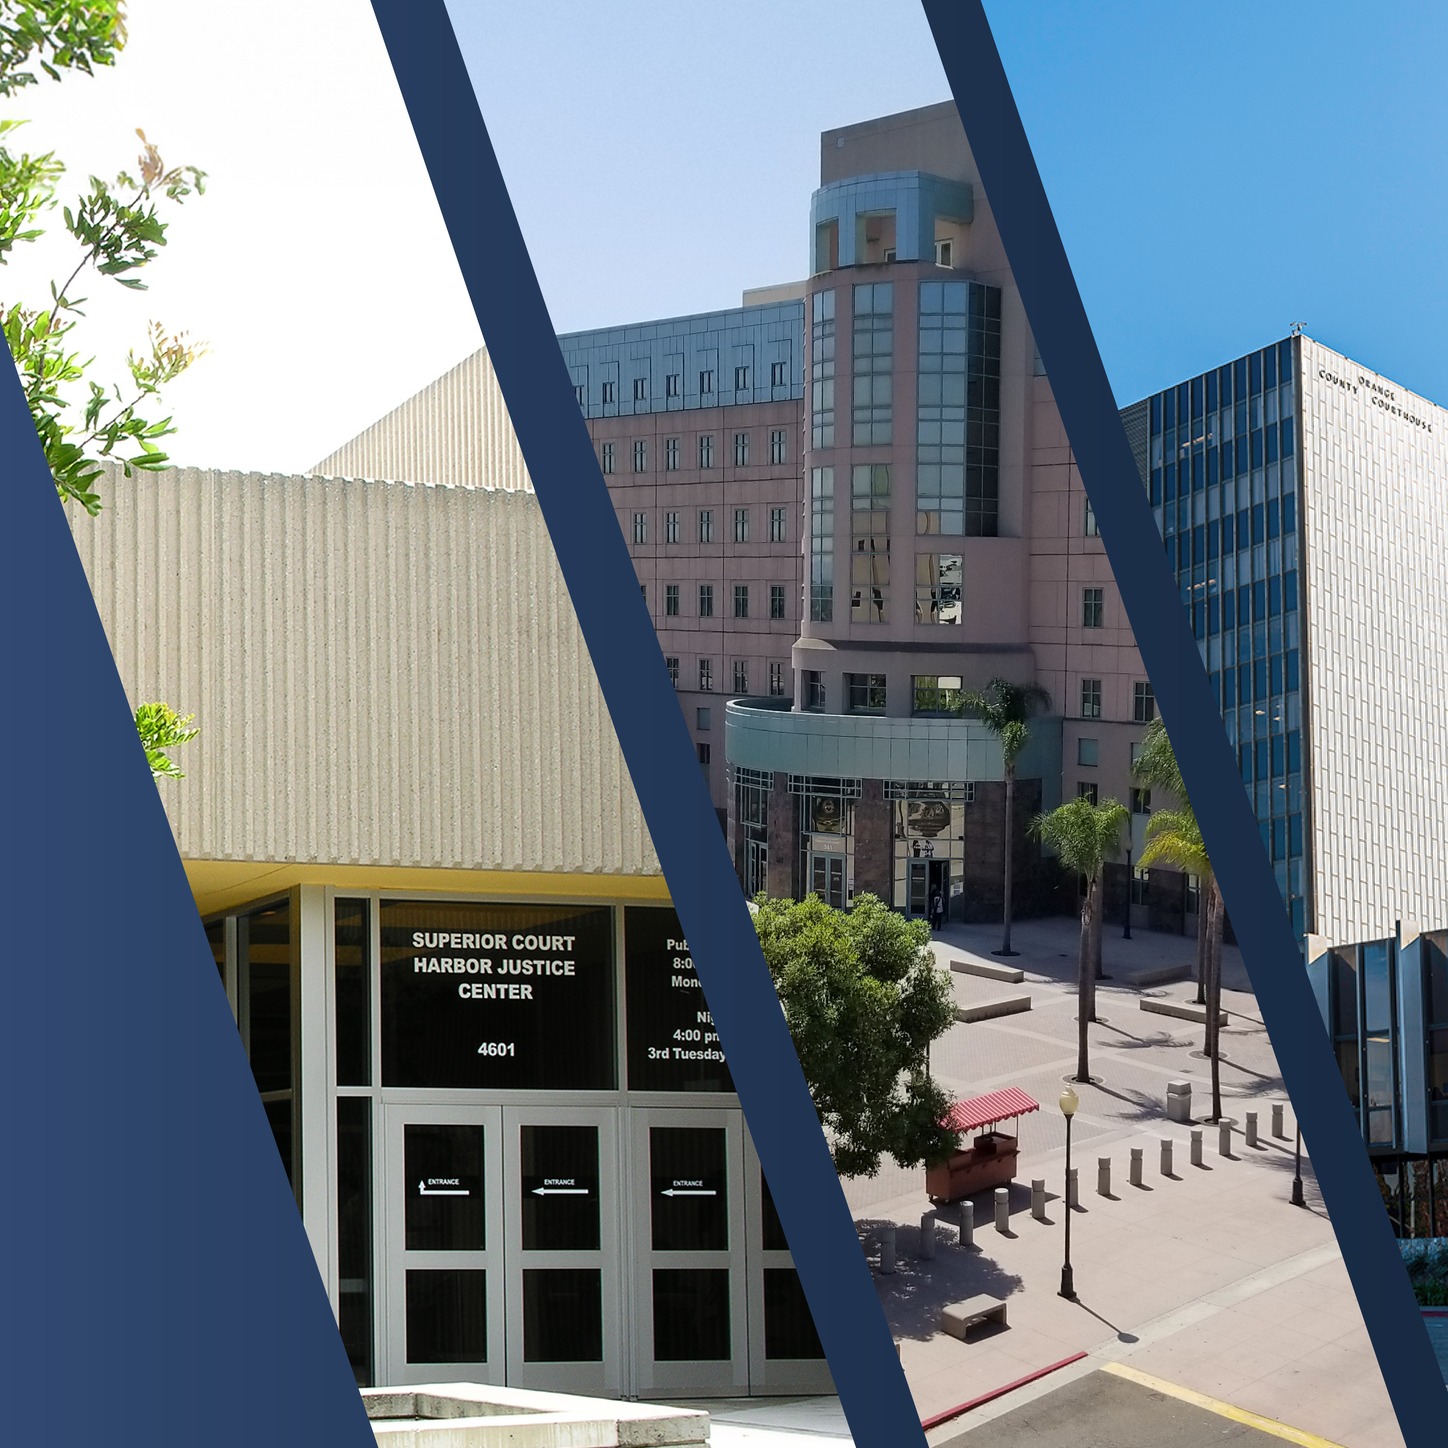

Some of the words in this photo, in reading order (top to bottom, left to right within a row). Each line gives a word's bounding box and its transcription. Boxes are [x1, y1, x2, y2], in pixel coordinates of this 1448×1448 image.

[1358, 376, 1396, 401] ORANGE
[1319, 370, 1359, 394] COUNTY
[1371, 396, 1433, 434] COURTHOUSE
[412, 932, 508, 949] SUPERIOR
[511, 934, 576, 951] COURT
[413, 957, 493, 974] HARBOR
[497, 959, 576, 976] JUSTICE
[672, 957, 696, 969] 8:0
[671, 975, 702, 987] Mon
[458, 983, 534, 999] CENTER
[673, 1029, 701, 1041] 4:00
[477, 1042, 516, 1057] 4601
[647, 1047, 670, 1060] 3rd
[672, 1047, 726, 1063] Tuesday
[427, 1178, 460, 1186] ENTRANCE
[543, 1178, 576, 1186] ENTRANCE
[672, 1180, 704, 1188] ENTRANCE
